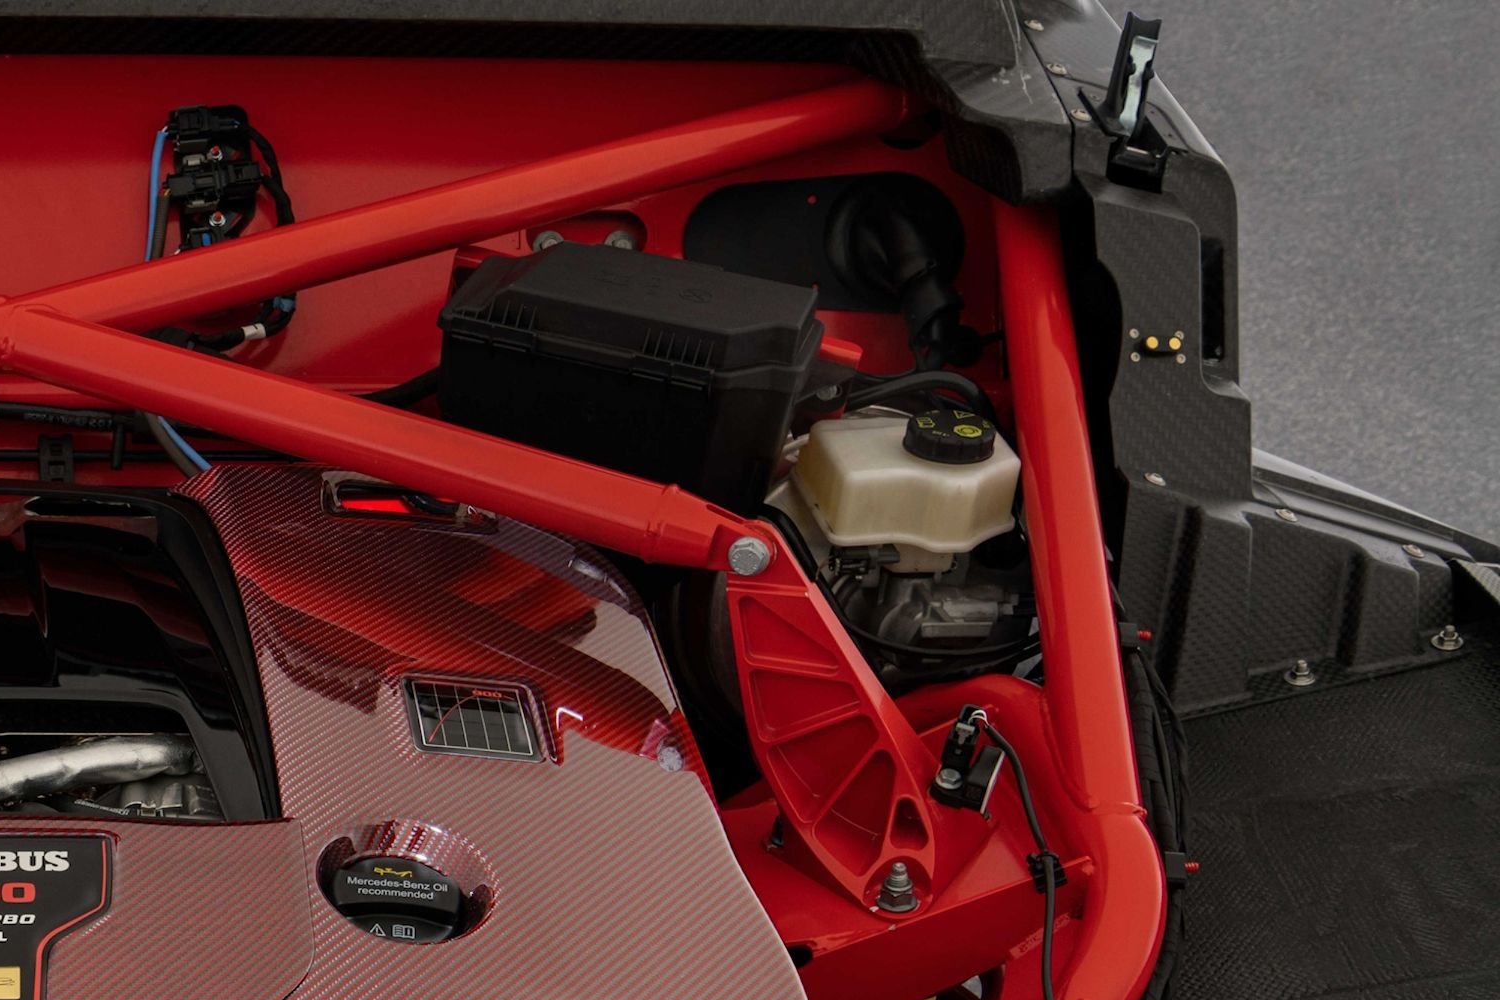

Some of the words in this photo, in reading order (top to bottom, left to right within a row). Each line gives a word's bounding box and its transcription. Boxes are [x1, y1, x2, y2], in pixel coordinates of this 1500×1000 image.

[347, 876, 431, 891] Mercedes-Benz
[433, 883, 448, 892] Oil
[357, 886, 434, 900] recommended
